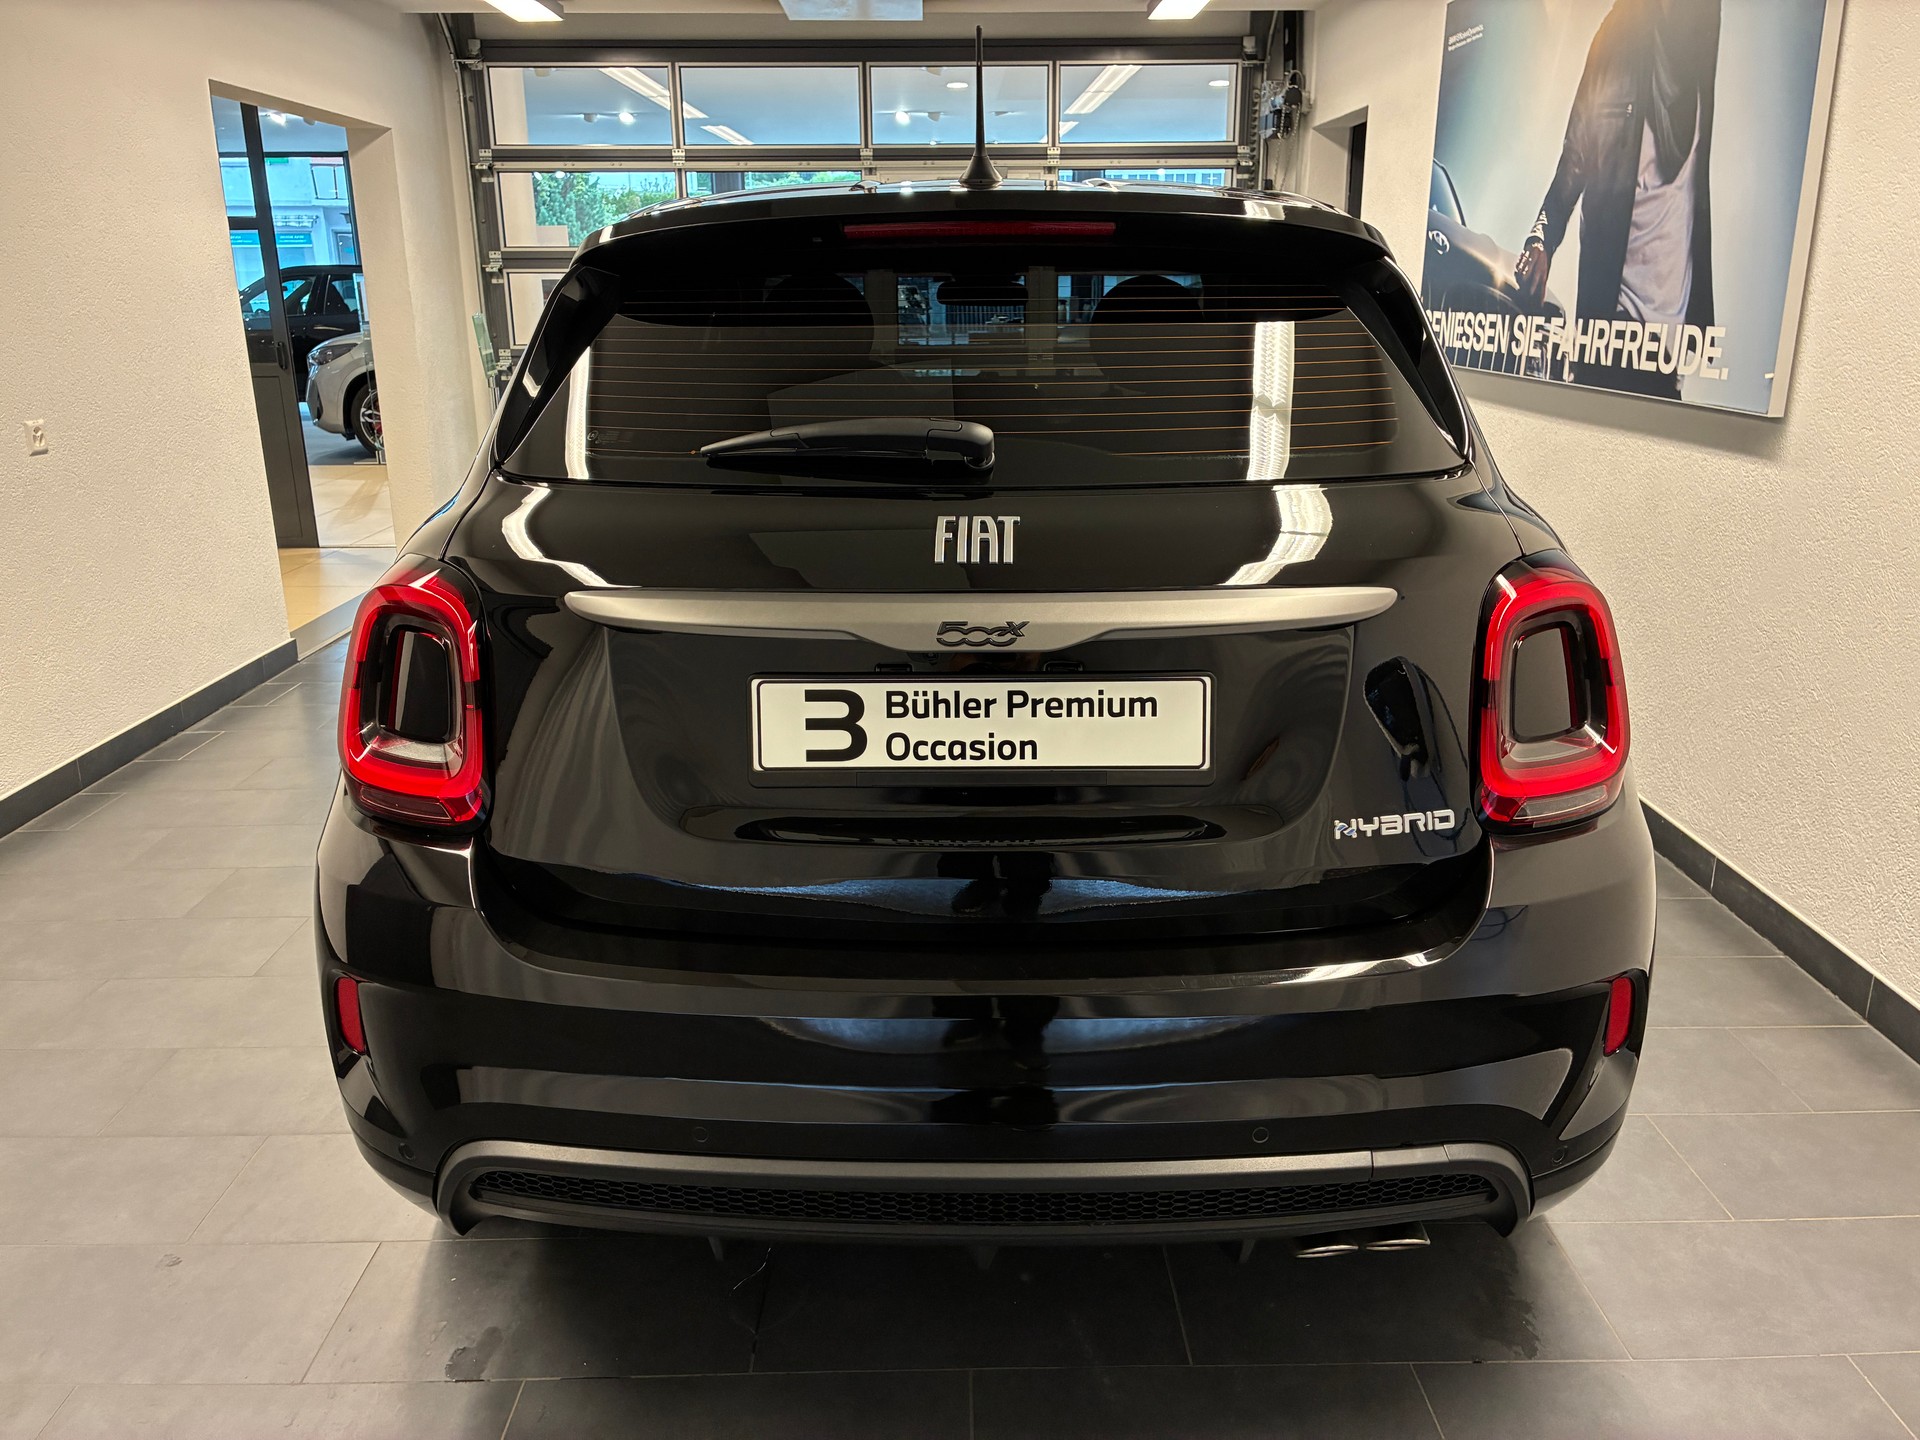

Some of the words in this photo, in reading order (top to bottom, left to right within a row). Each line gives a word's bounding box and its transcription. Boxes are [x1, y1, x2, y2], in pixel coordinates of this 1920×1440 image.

[1511, 314, 1546, 358] SIE
[1549, 316, 1729, 380] FAHRFREUDE.
[934, 515, 1021, 564] FIAT
[885, 690, 998, 719] Bühler
[1007, 689, 1158, 719] Premium
[885, 732, 1038, 761] Occasion
[1333, 808, 1456, 840] HYBRID
